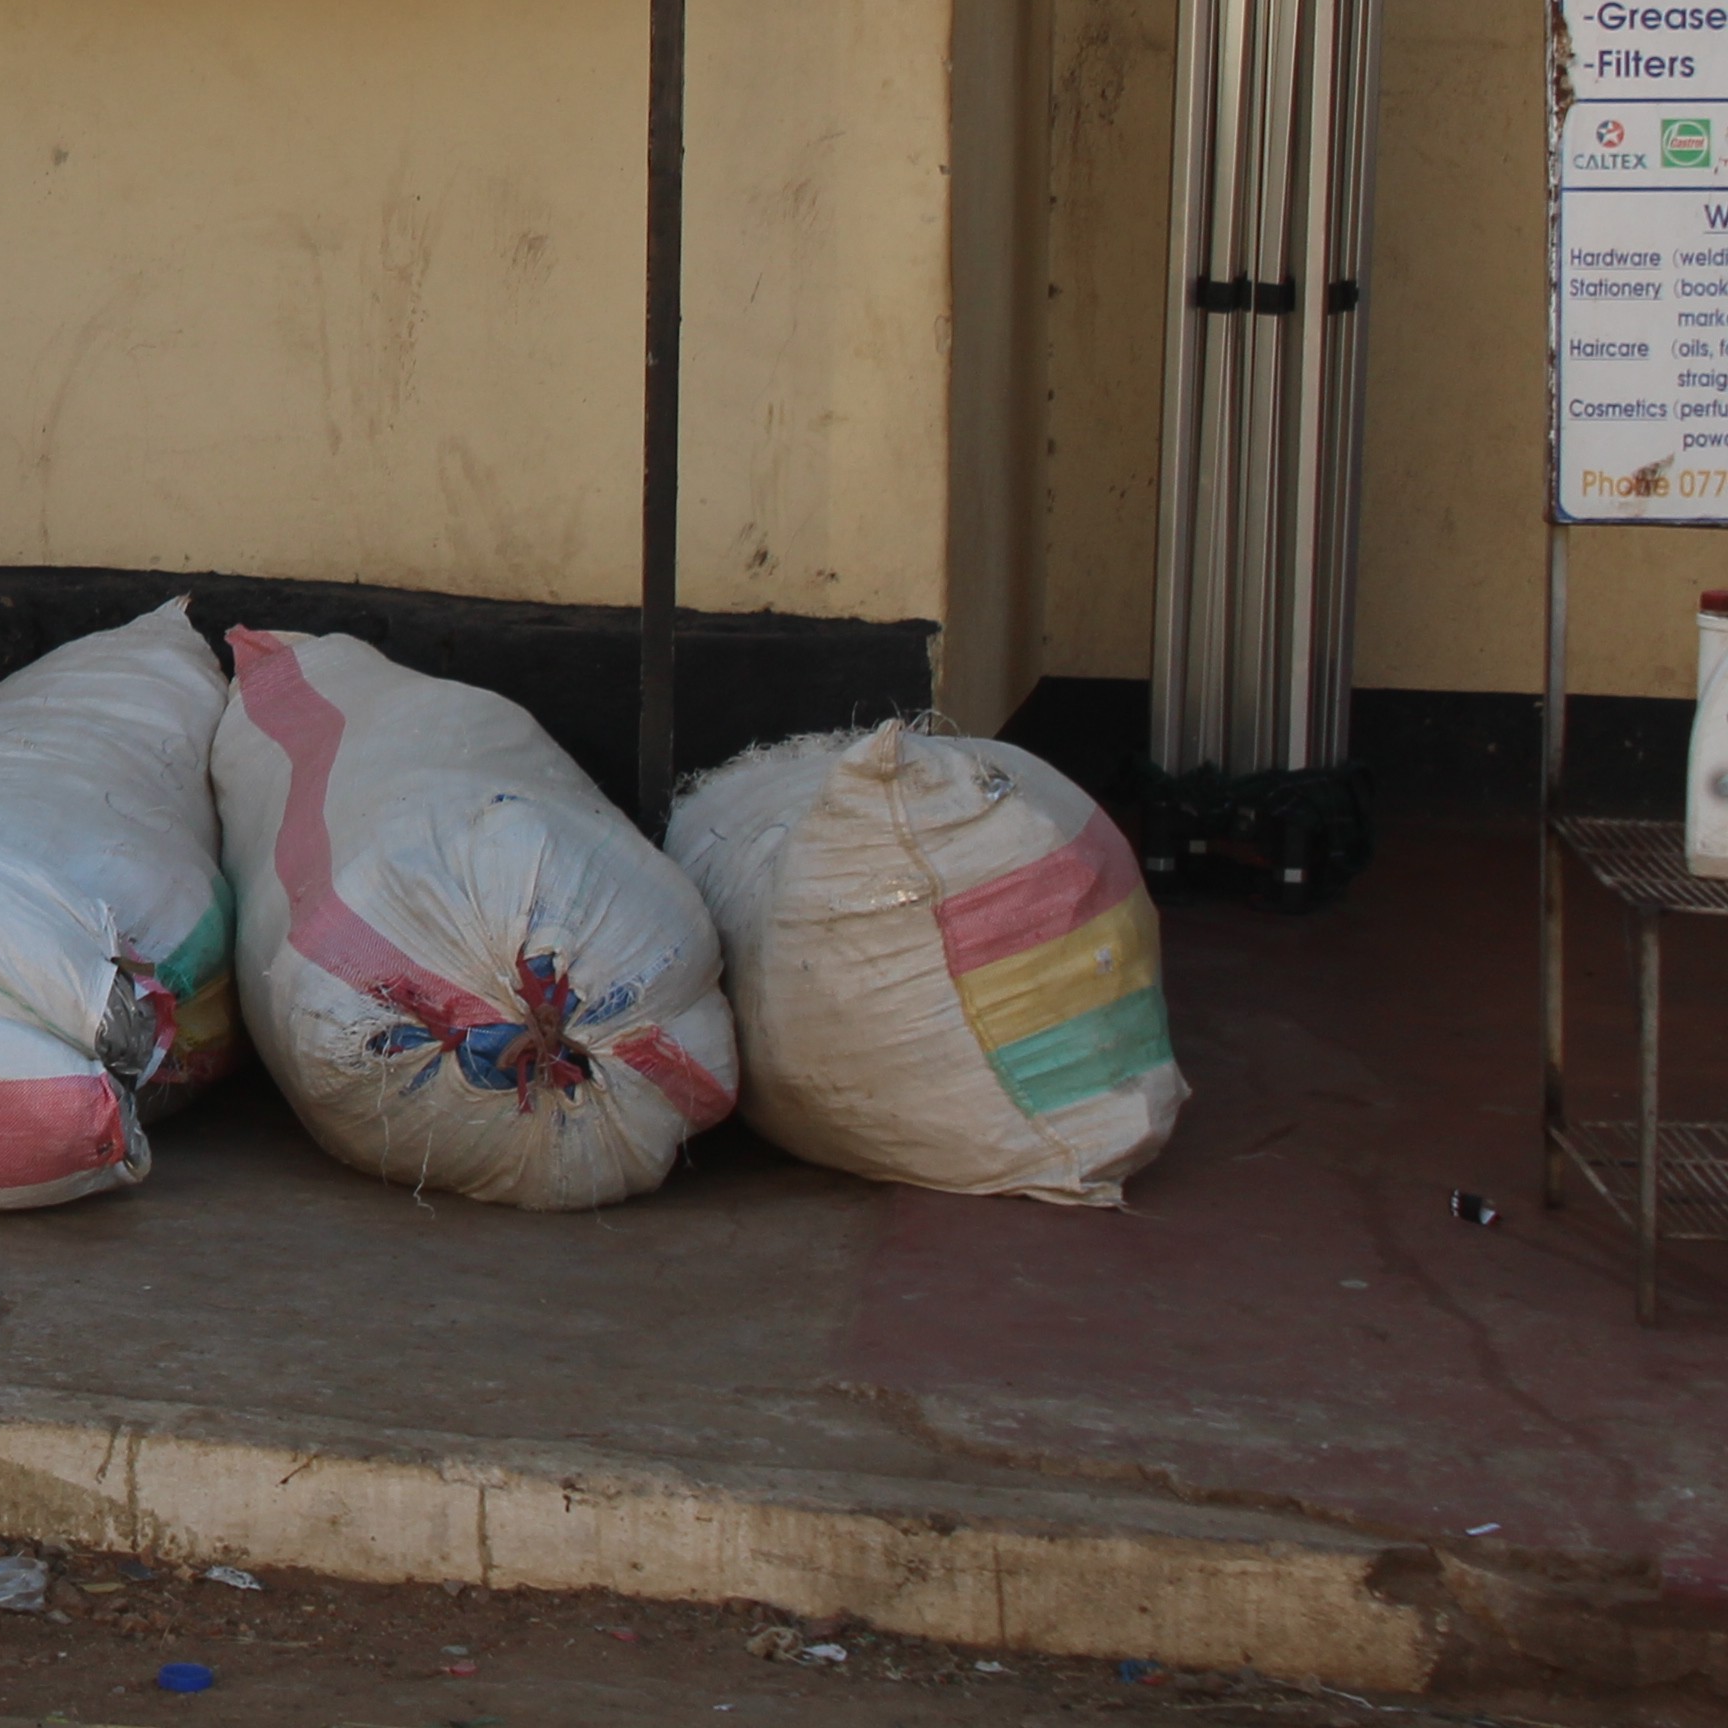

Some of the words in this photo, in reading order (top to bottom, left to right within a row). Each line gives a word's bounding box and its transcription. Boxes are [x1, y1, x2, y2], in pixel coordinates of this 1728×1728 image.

[1573, 153, 1648, 170] CALTEX
[1570, 247, 1661, 267] Hardware
[1570, 278, 1663, 300] Stationery
[1677, 307, 1728, 327] mark
[1570, 339, 1649, 358] Haircare
[1569, 398, 1668, 418] Cosmetics
